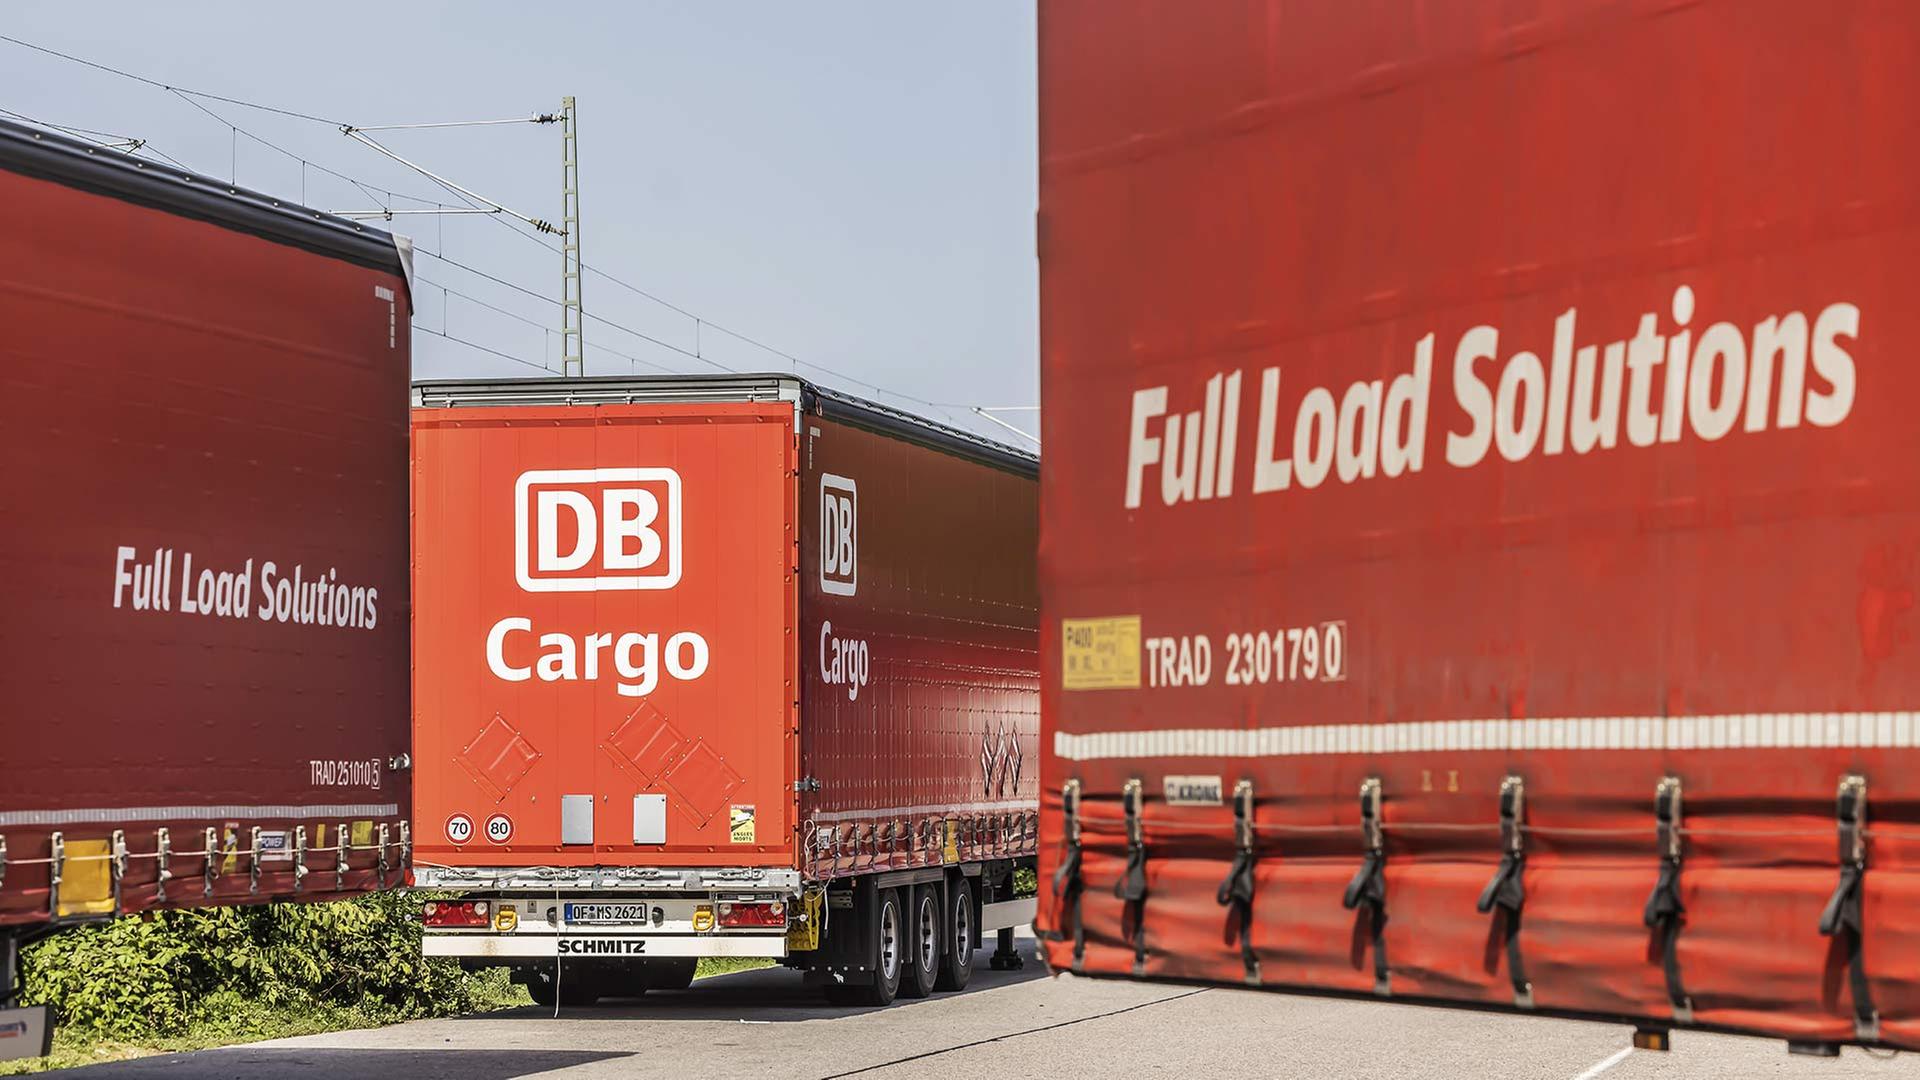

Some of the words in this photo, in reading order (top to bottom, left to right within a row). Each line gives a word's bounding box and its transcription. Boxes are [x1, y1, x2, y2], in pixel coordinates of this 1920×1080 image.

[1125, 368, 1241, 509] Full
[1253, 332, 1435, 494] Load
[1445, 285, 1860, 468] Solutions
[537, 489, 662, 571] DB
[825, 494, 853, 576] DB
[113, 546, 173, 612] Full
[180, 552, 253, 618] Load
[258, 561, 378, 630] Solutions
[486, 617, 710, 697] Cargo
[820, 620, 868, 701] Cargo
[1146, 635, 1212, 687] TRAD
[310, 760, 336, 786] TRAD
[451, 822, 468, 835] 70
[490, 822, 508, 835] 80
[573, 906, 588, 919] OF
[597, 906, 612, 919] MS
[614, 906, 644, 919] 2621
[558, 940, 646, 953] SCHMITZ
